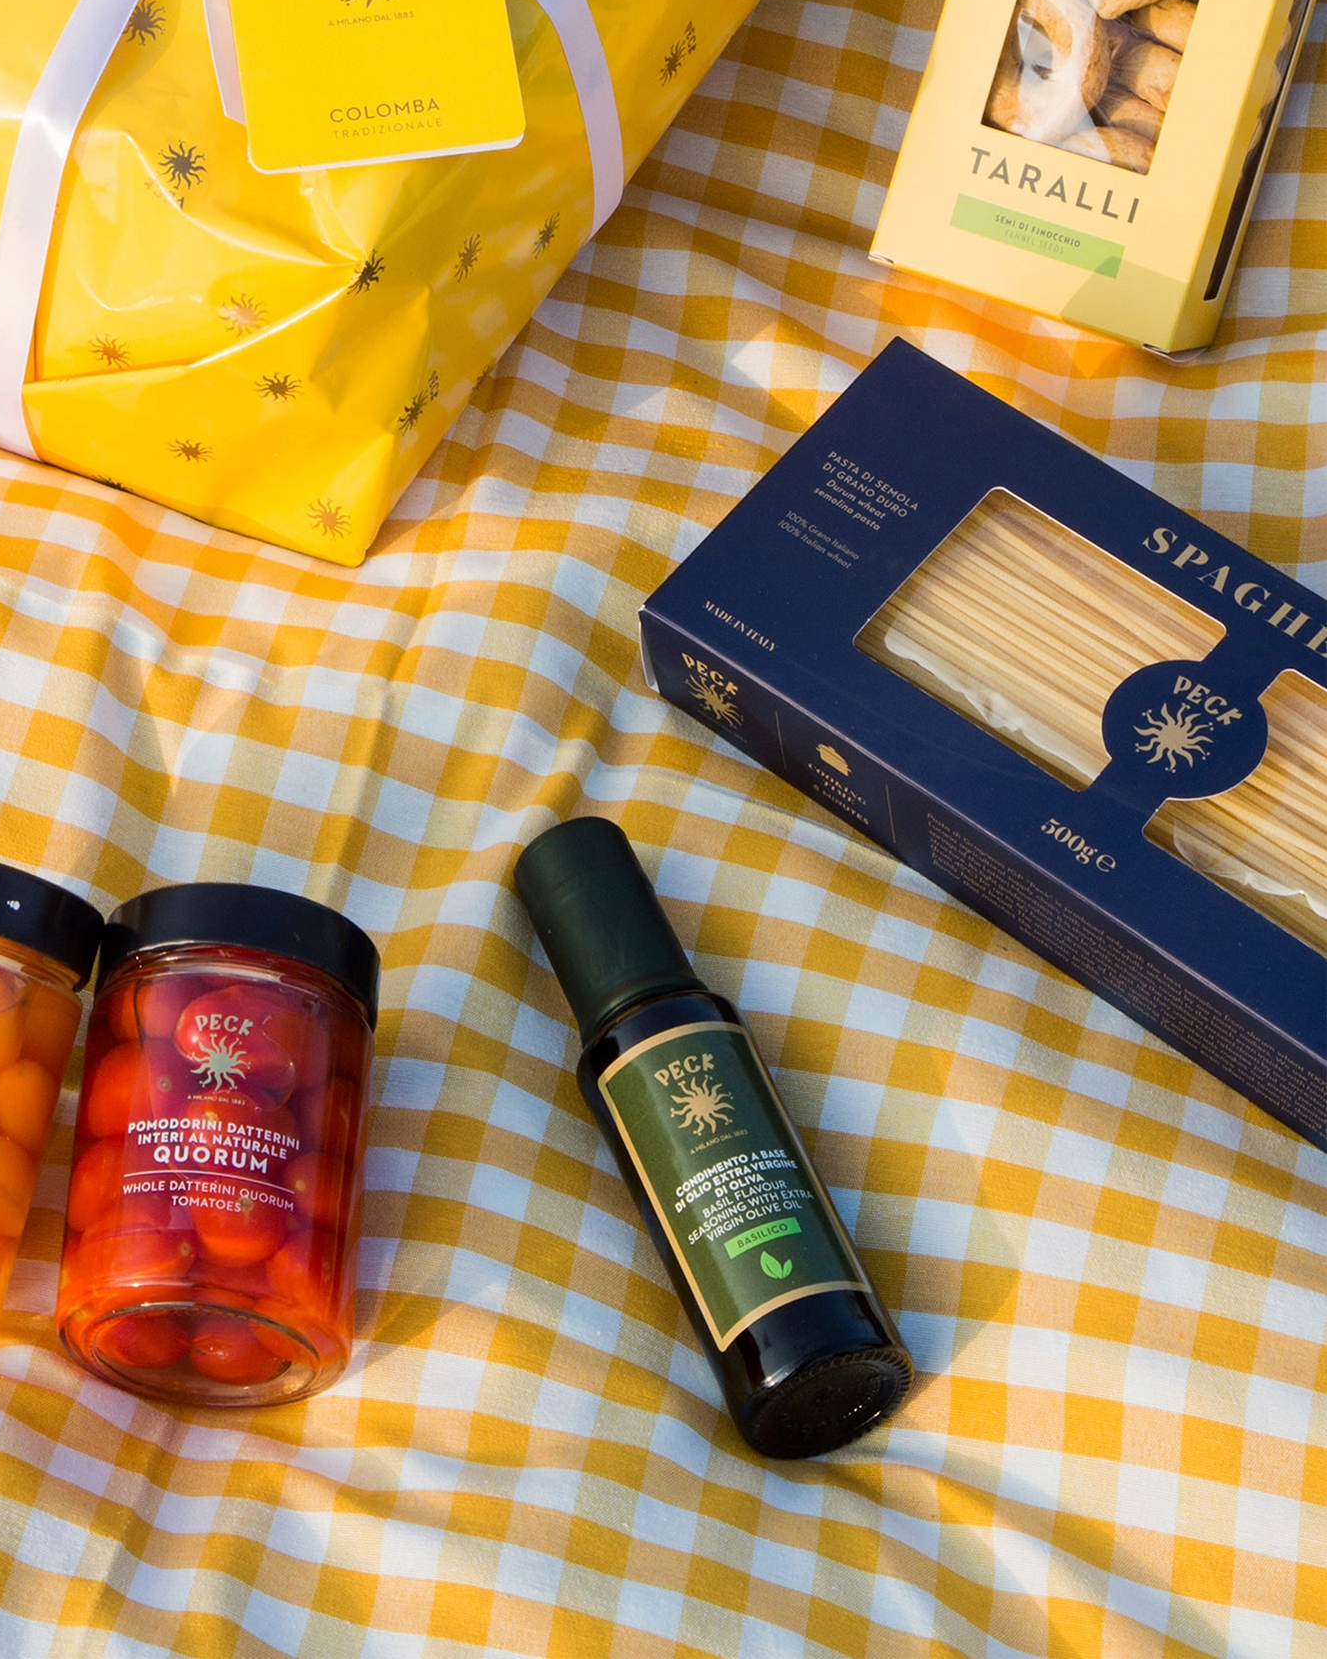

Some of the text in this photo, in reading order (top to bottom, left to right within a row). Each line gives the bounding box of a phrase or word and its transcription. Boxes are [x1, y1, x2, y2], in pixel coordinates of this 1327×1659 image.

[330, 98, 440, 123] COLOMBA
[333, 118, 443, 140] TRADIZIONALE
[971, 146, 1140, 224] TARALLI
[995, 214, 1081, 248] SEMI DI FINOCCHIO
[822, 462, 908, 518] DI GRANO DURO
[826, 479, 886, 520] Durum wheat
[828, 451, 919, 511] PASTA DI SEMOLA
[785, 510, 808, 528] 100%
[808, 524, 831, 542] Grano
[814, 487, 881, 531] semolina pasta
[778, 519, 852, 569] 100% Italian wheat
[703, 600, 776, 652] MADE IN ITALY
[681, 651, 739, 696] PECK
[1172, 675, 1243, 726] PECK
[1040, 817, 1098, 865] 500g
[195, 1014, 254, 1036] PECK
[654, 1053, 714, 1087] PECK
[128, 1118, 300, 1151] POMODORINI DATTERINI
[138, 1131, 287, 1160] INTERI AL NATURALE
[153, 1145, 268, 1175] QUORUM
[676, 1149, 787, 1198] CONDIMENTO A BASE
[123, 1180, 295, 1212] WHOLE DATTERINI QUORUM
[171, 1196, 241, 1213] TOMATOES
[675, 1160, 798, 1213] DI OLIO EXTRA VERGINE
[702, 1180, 787, 1219] BASIL FLAVOUR
[715, 1174, 765, 1198] DI OLIVA
[688, 1190, 815, 1245] SEASONING WITH EXTRA
[706, 1200, 803, 1242] VIRGIN OLIVE OIL
[737, 1222, 789, 1249] BASILICO
